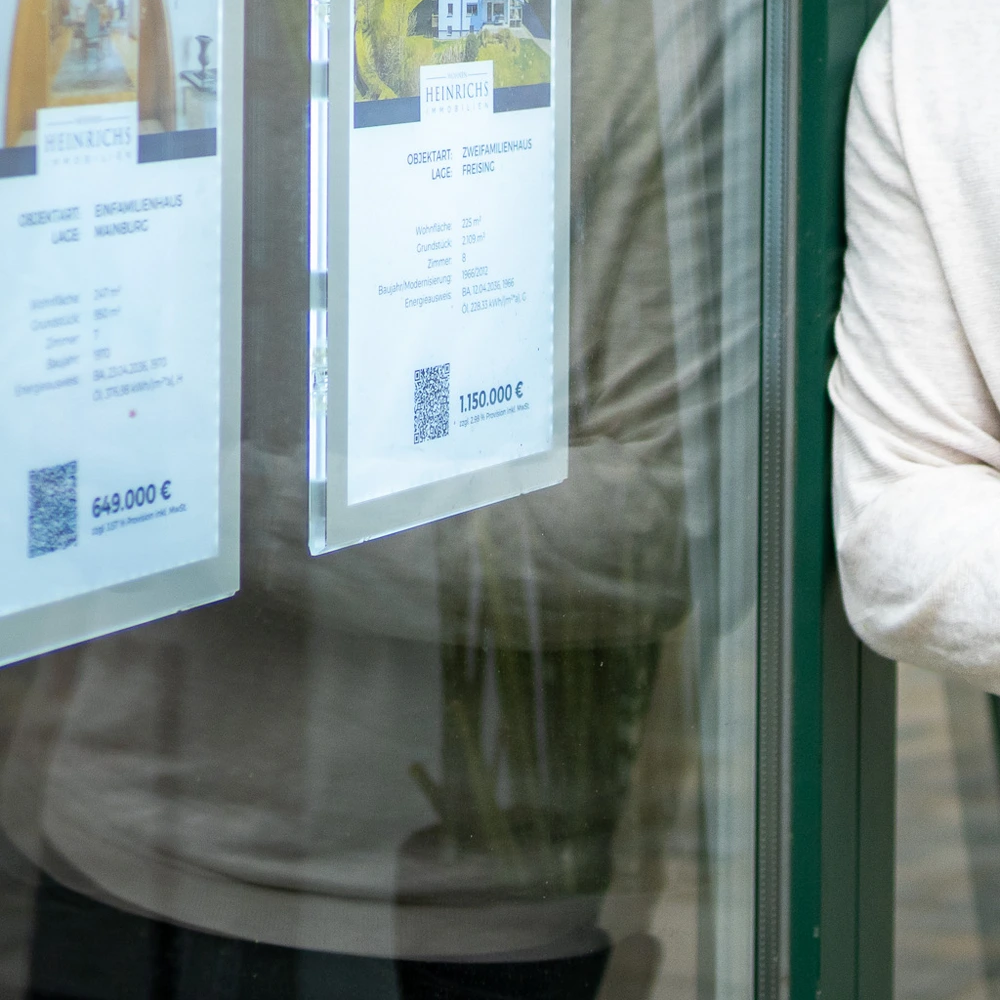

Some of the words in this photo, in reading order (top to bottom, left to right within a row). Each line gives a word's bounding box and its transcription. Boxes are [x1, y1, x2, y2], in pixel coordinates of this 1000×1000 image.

[426, 82, 489, 103] HEINRICHS
[45, 126, 131, 153] HEINRICHS
[407, 149, 453, 166] OBJEKTART:
[463, 139, 533, 159] ZWEIFAMILIENHAUS
[432, 167, 453, 181] LAGE:
[463, 161, 495, 176] FREISING
[94, 193, 184, 219] EINFAMILIENHAUS
[94, 218, 150, 239] MAINBURG
[462, 218, 473, 229] 225
[428, 257, 452, 270] Zimmer:
[462, 253, 467, 263] 8
[460, 384, 513, 413] 1.150.000
[516, 381, 524, 399] €
[92, 484, 157, 519] 649.000
[160, 479, 172, 501] €
